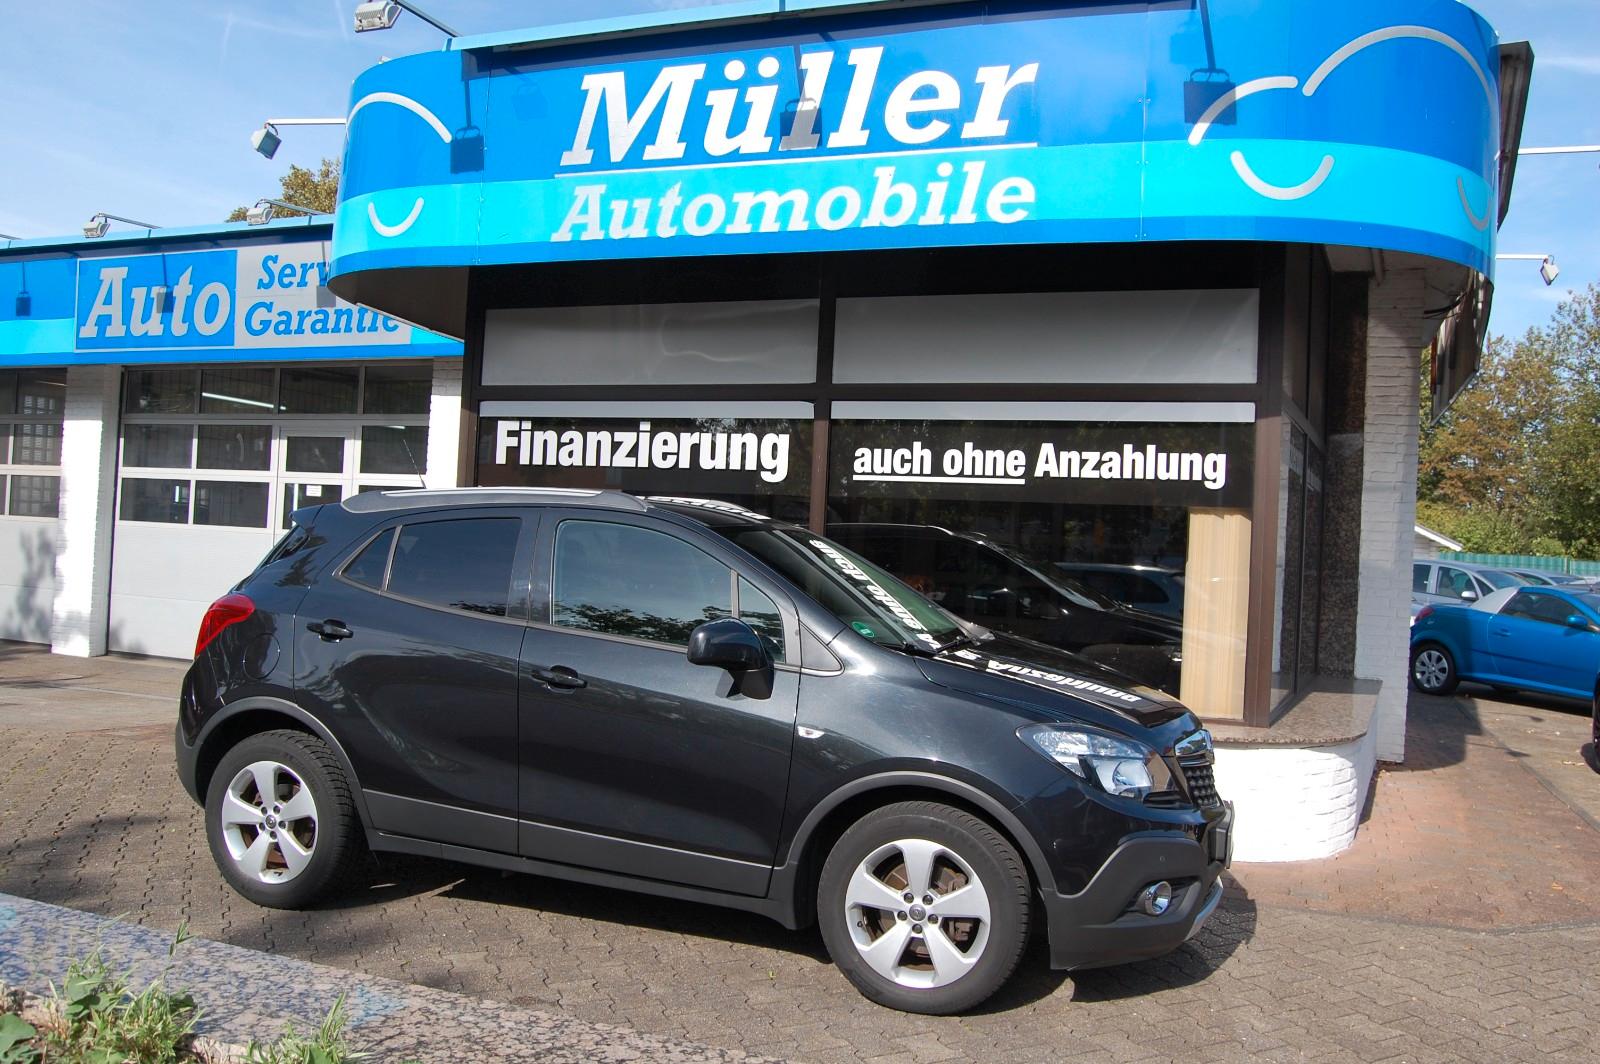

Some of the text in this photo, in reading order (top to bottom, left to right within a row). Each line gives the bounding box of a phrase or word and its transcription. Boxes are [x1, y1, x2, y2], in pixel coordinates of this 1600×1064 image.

[559, 46, 1039, 166] Müller
[551, 160, 1036, 242] Automobile
[79, 265, 231, 338] Auto
[256, 254, 330, 290] Serv
[495, 420, 791, 483] Finanzierung
[853, 441, 1227, 490] auch ohne Anzahlung
